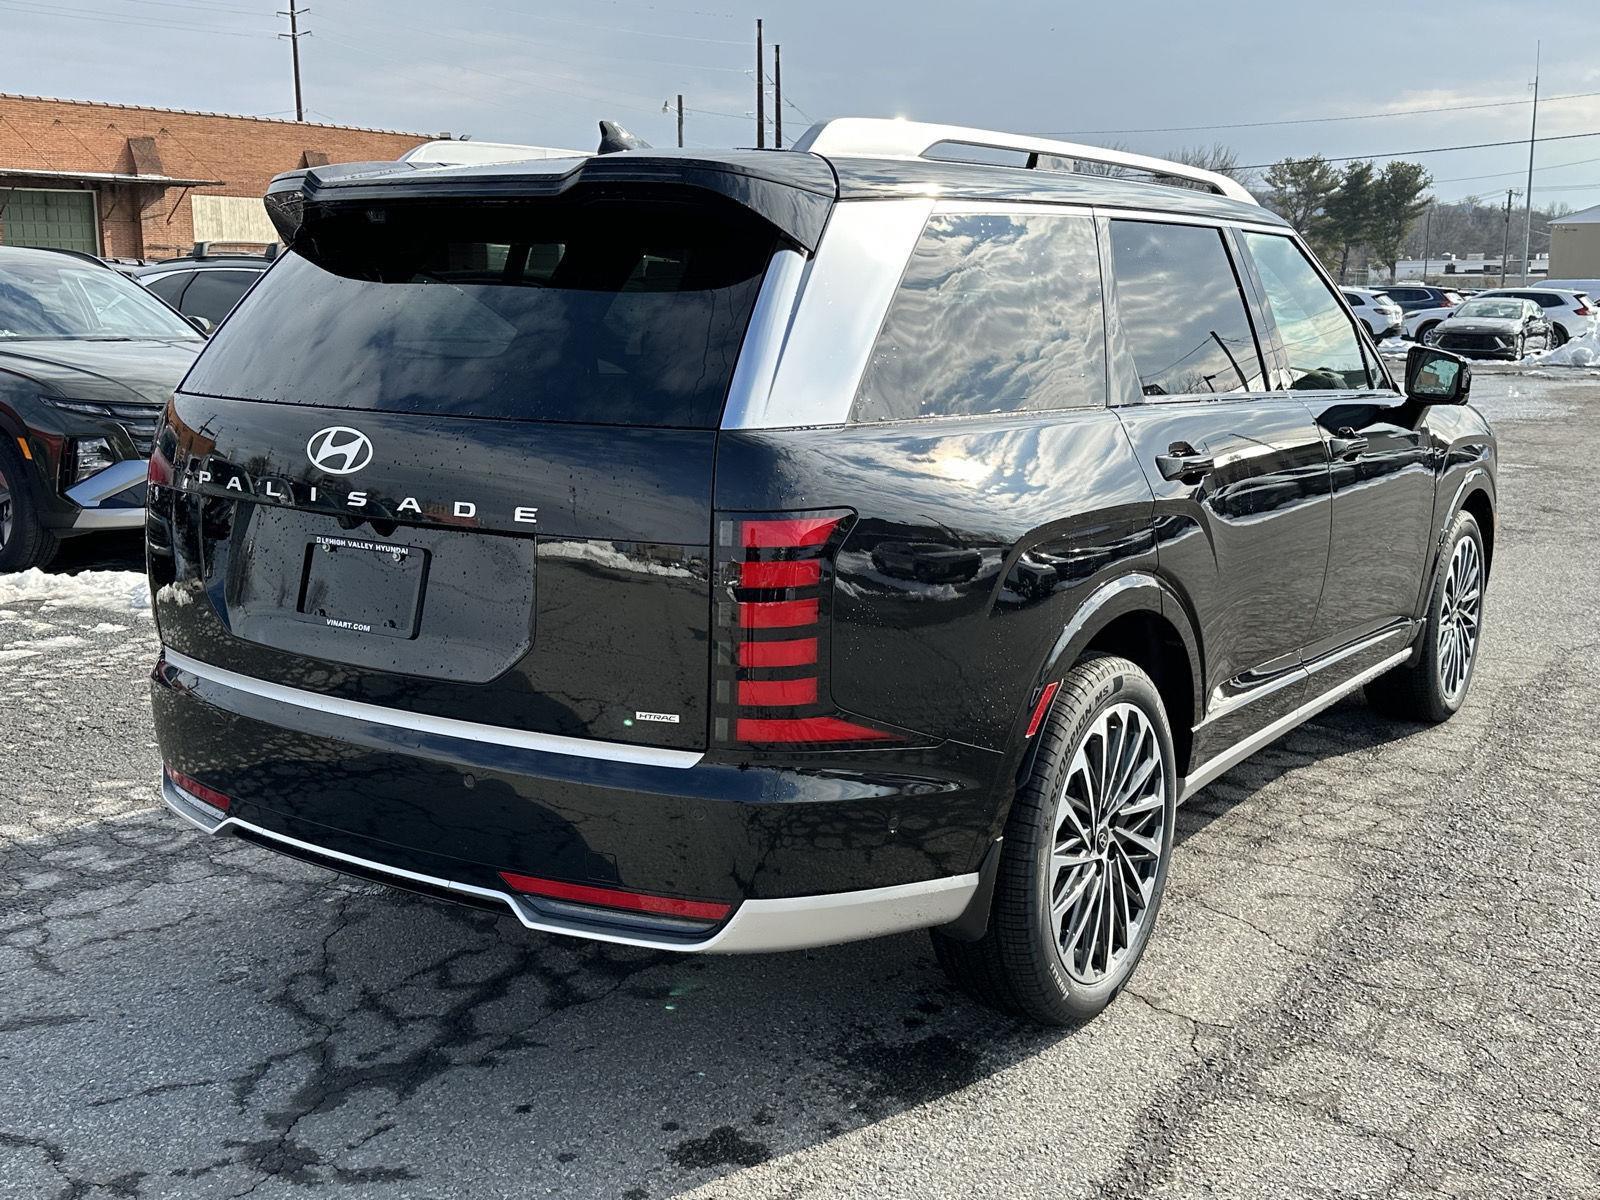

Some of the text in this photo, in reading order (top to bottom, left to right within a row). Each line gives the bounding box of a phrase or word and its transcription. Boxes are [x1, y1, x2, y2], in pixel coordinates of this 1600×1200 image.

[199, 470, 538, 523] PALISADE
[321, 537, 409, 554] LEHIGH VALLEY HYUNDAI
[326, 618, 371, 632] VINART.COM
[639, 713, 677, 721] HTRAC
[1051, 704, 1092, 806] SCORPION
